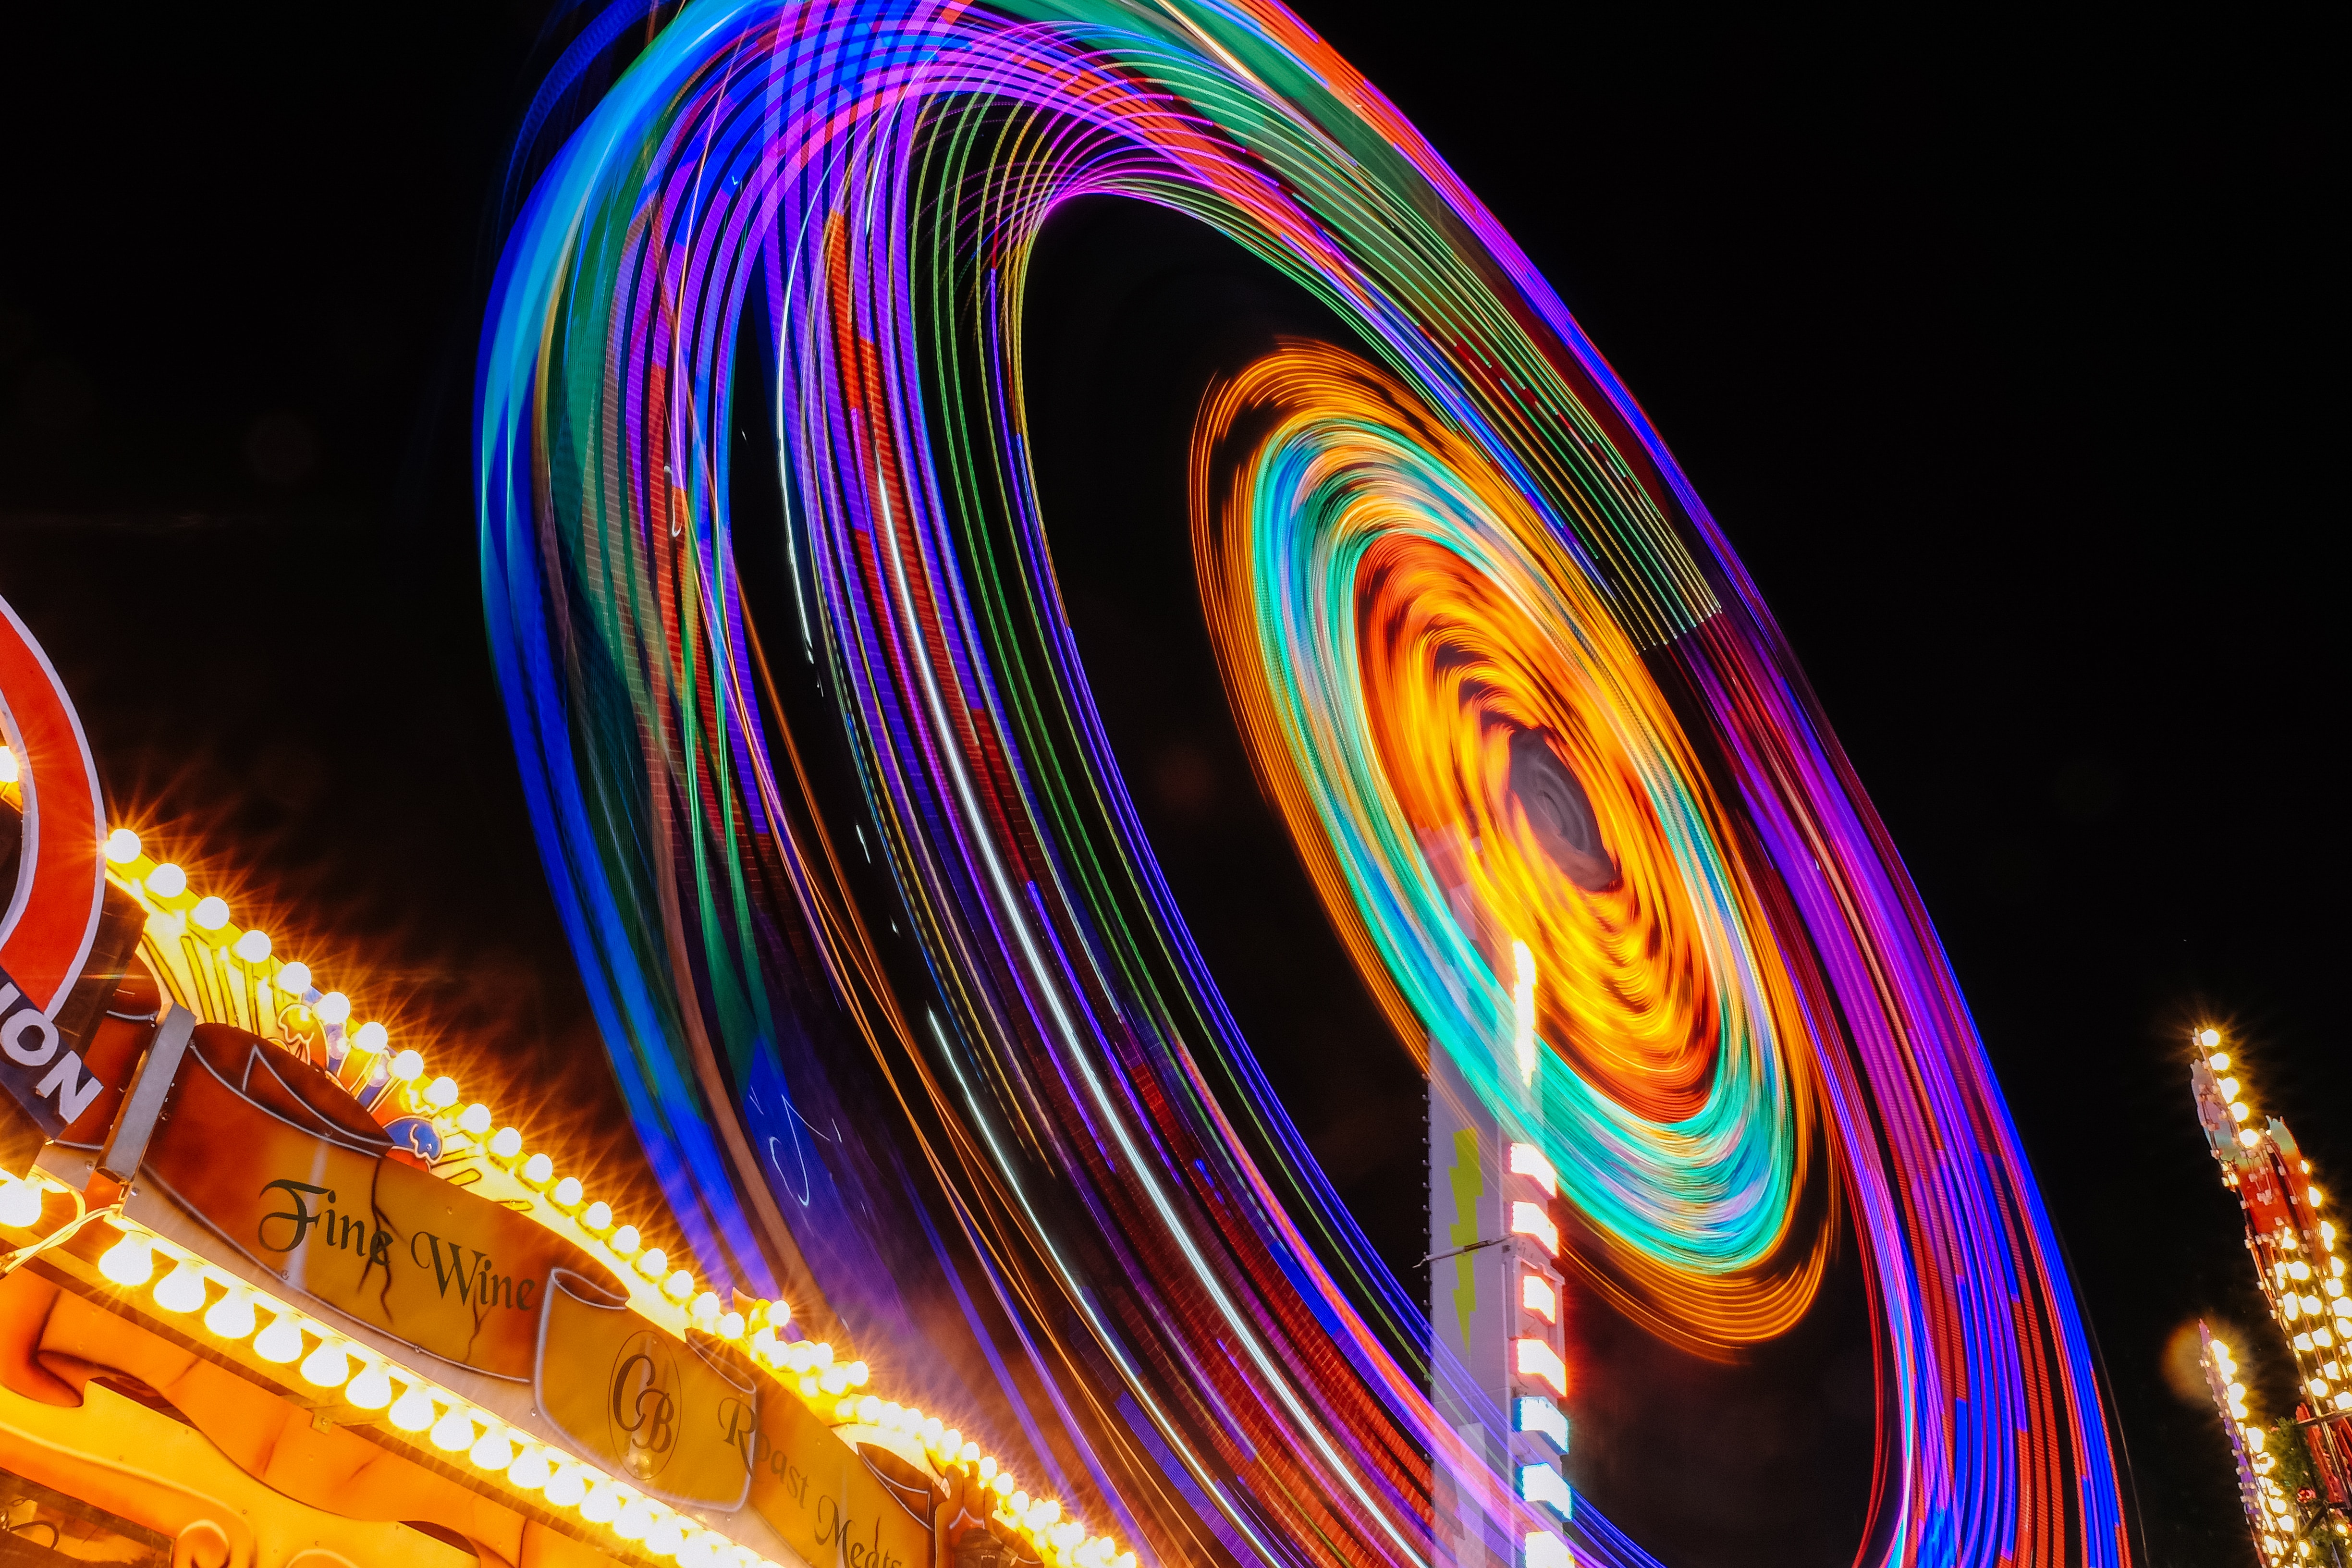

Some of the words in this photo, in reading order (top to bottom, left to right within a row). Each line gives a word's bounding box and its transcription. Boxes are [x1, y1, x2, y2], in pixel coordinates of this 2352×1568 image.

[257, 1179, 395, 1266] Fine
[411, 1231, 536, 1311] Wine
[613, 1354, 674, 1453] CB
[718, 1397, 809, 1509] Roast
